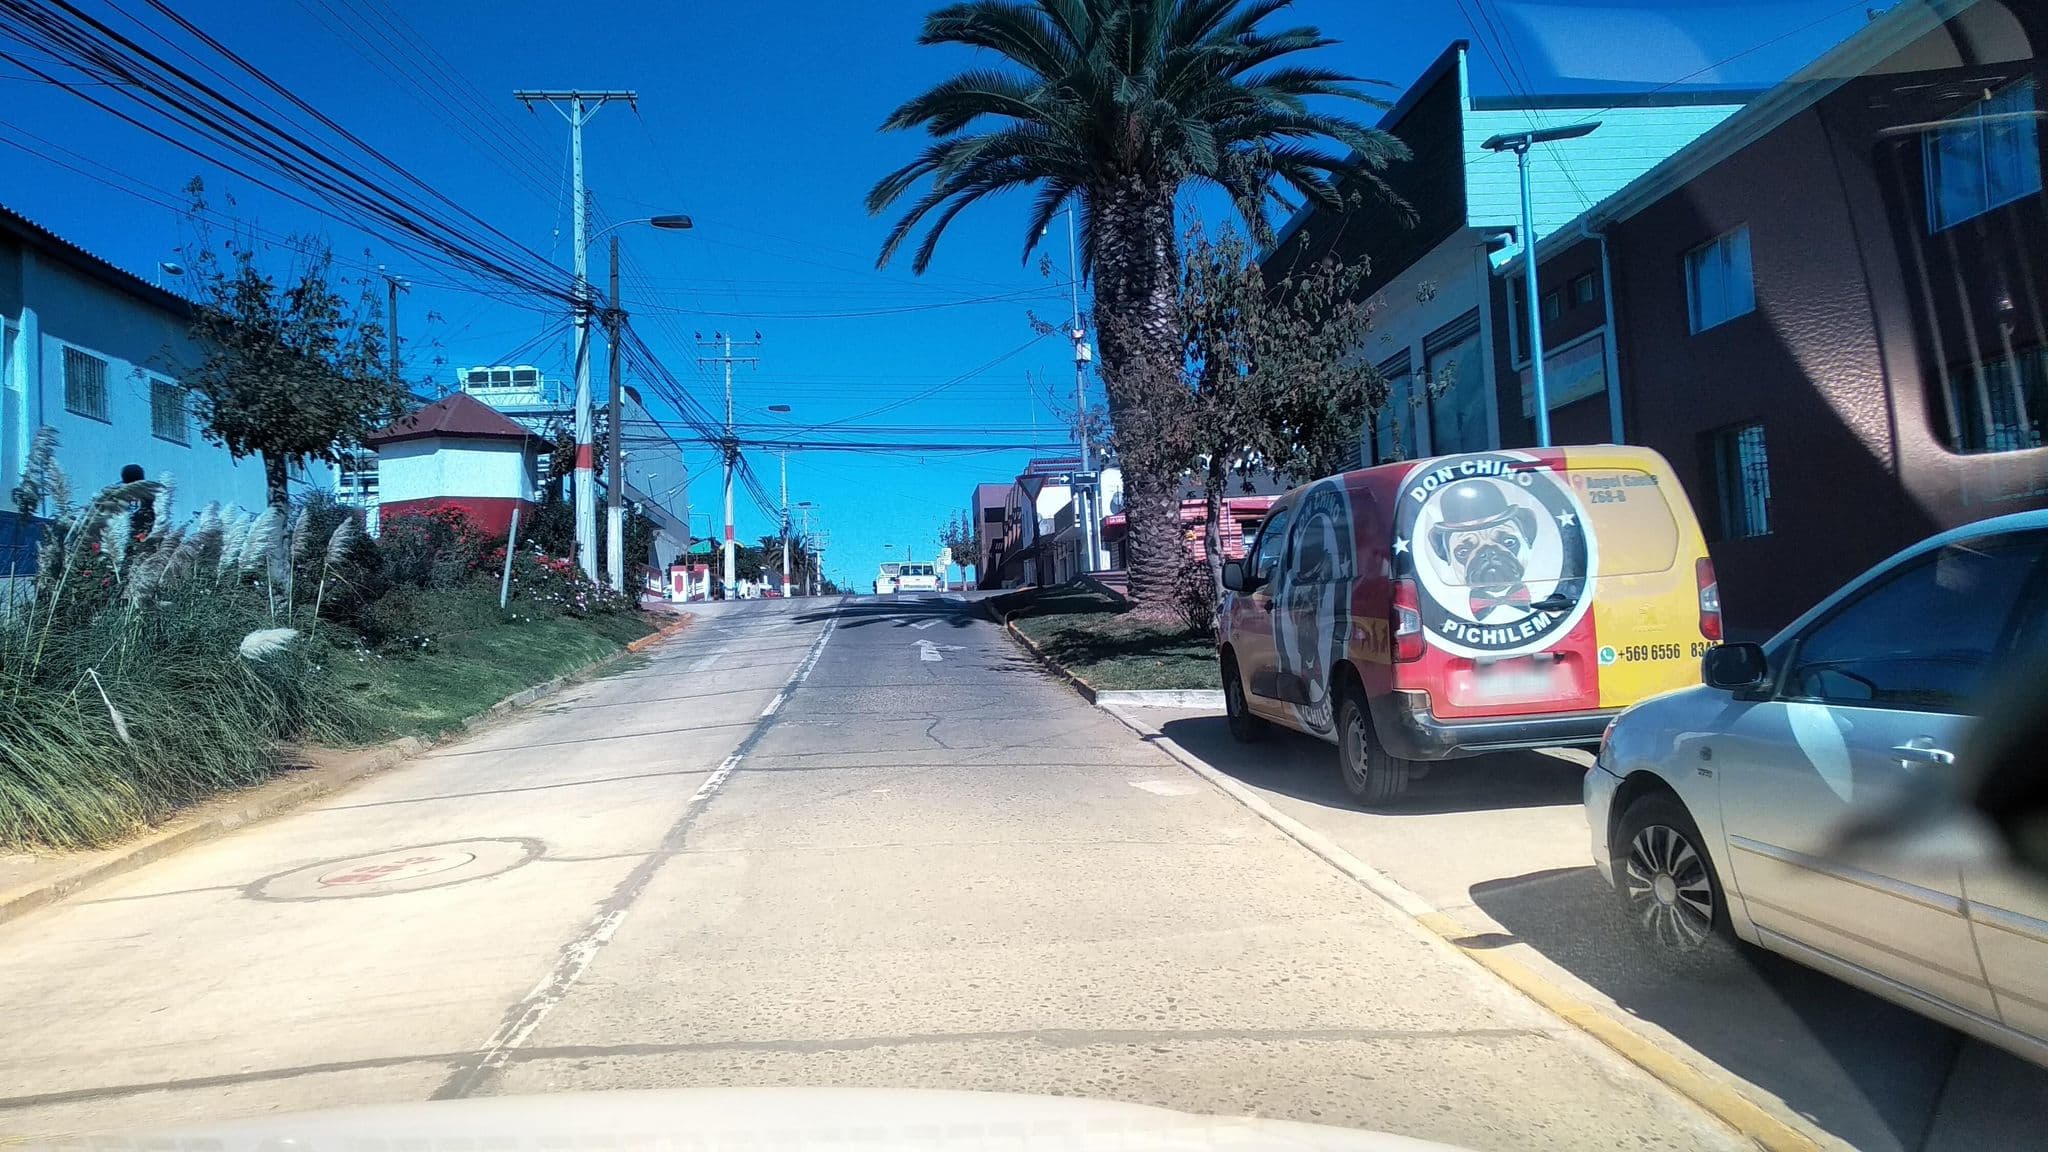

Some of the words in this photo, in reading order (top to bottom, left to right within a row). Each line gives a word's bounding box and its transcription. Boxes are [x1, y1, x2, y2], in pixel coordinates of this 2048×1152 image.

[1410, 466, 1455, 503] DON
[1460, 460, 1533, 487] CHINO
[1618, 645, 1648, 662] +569
[1651, 643, 1681, 660] 6556
